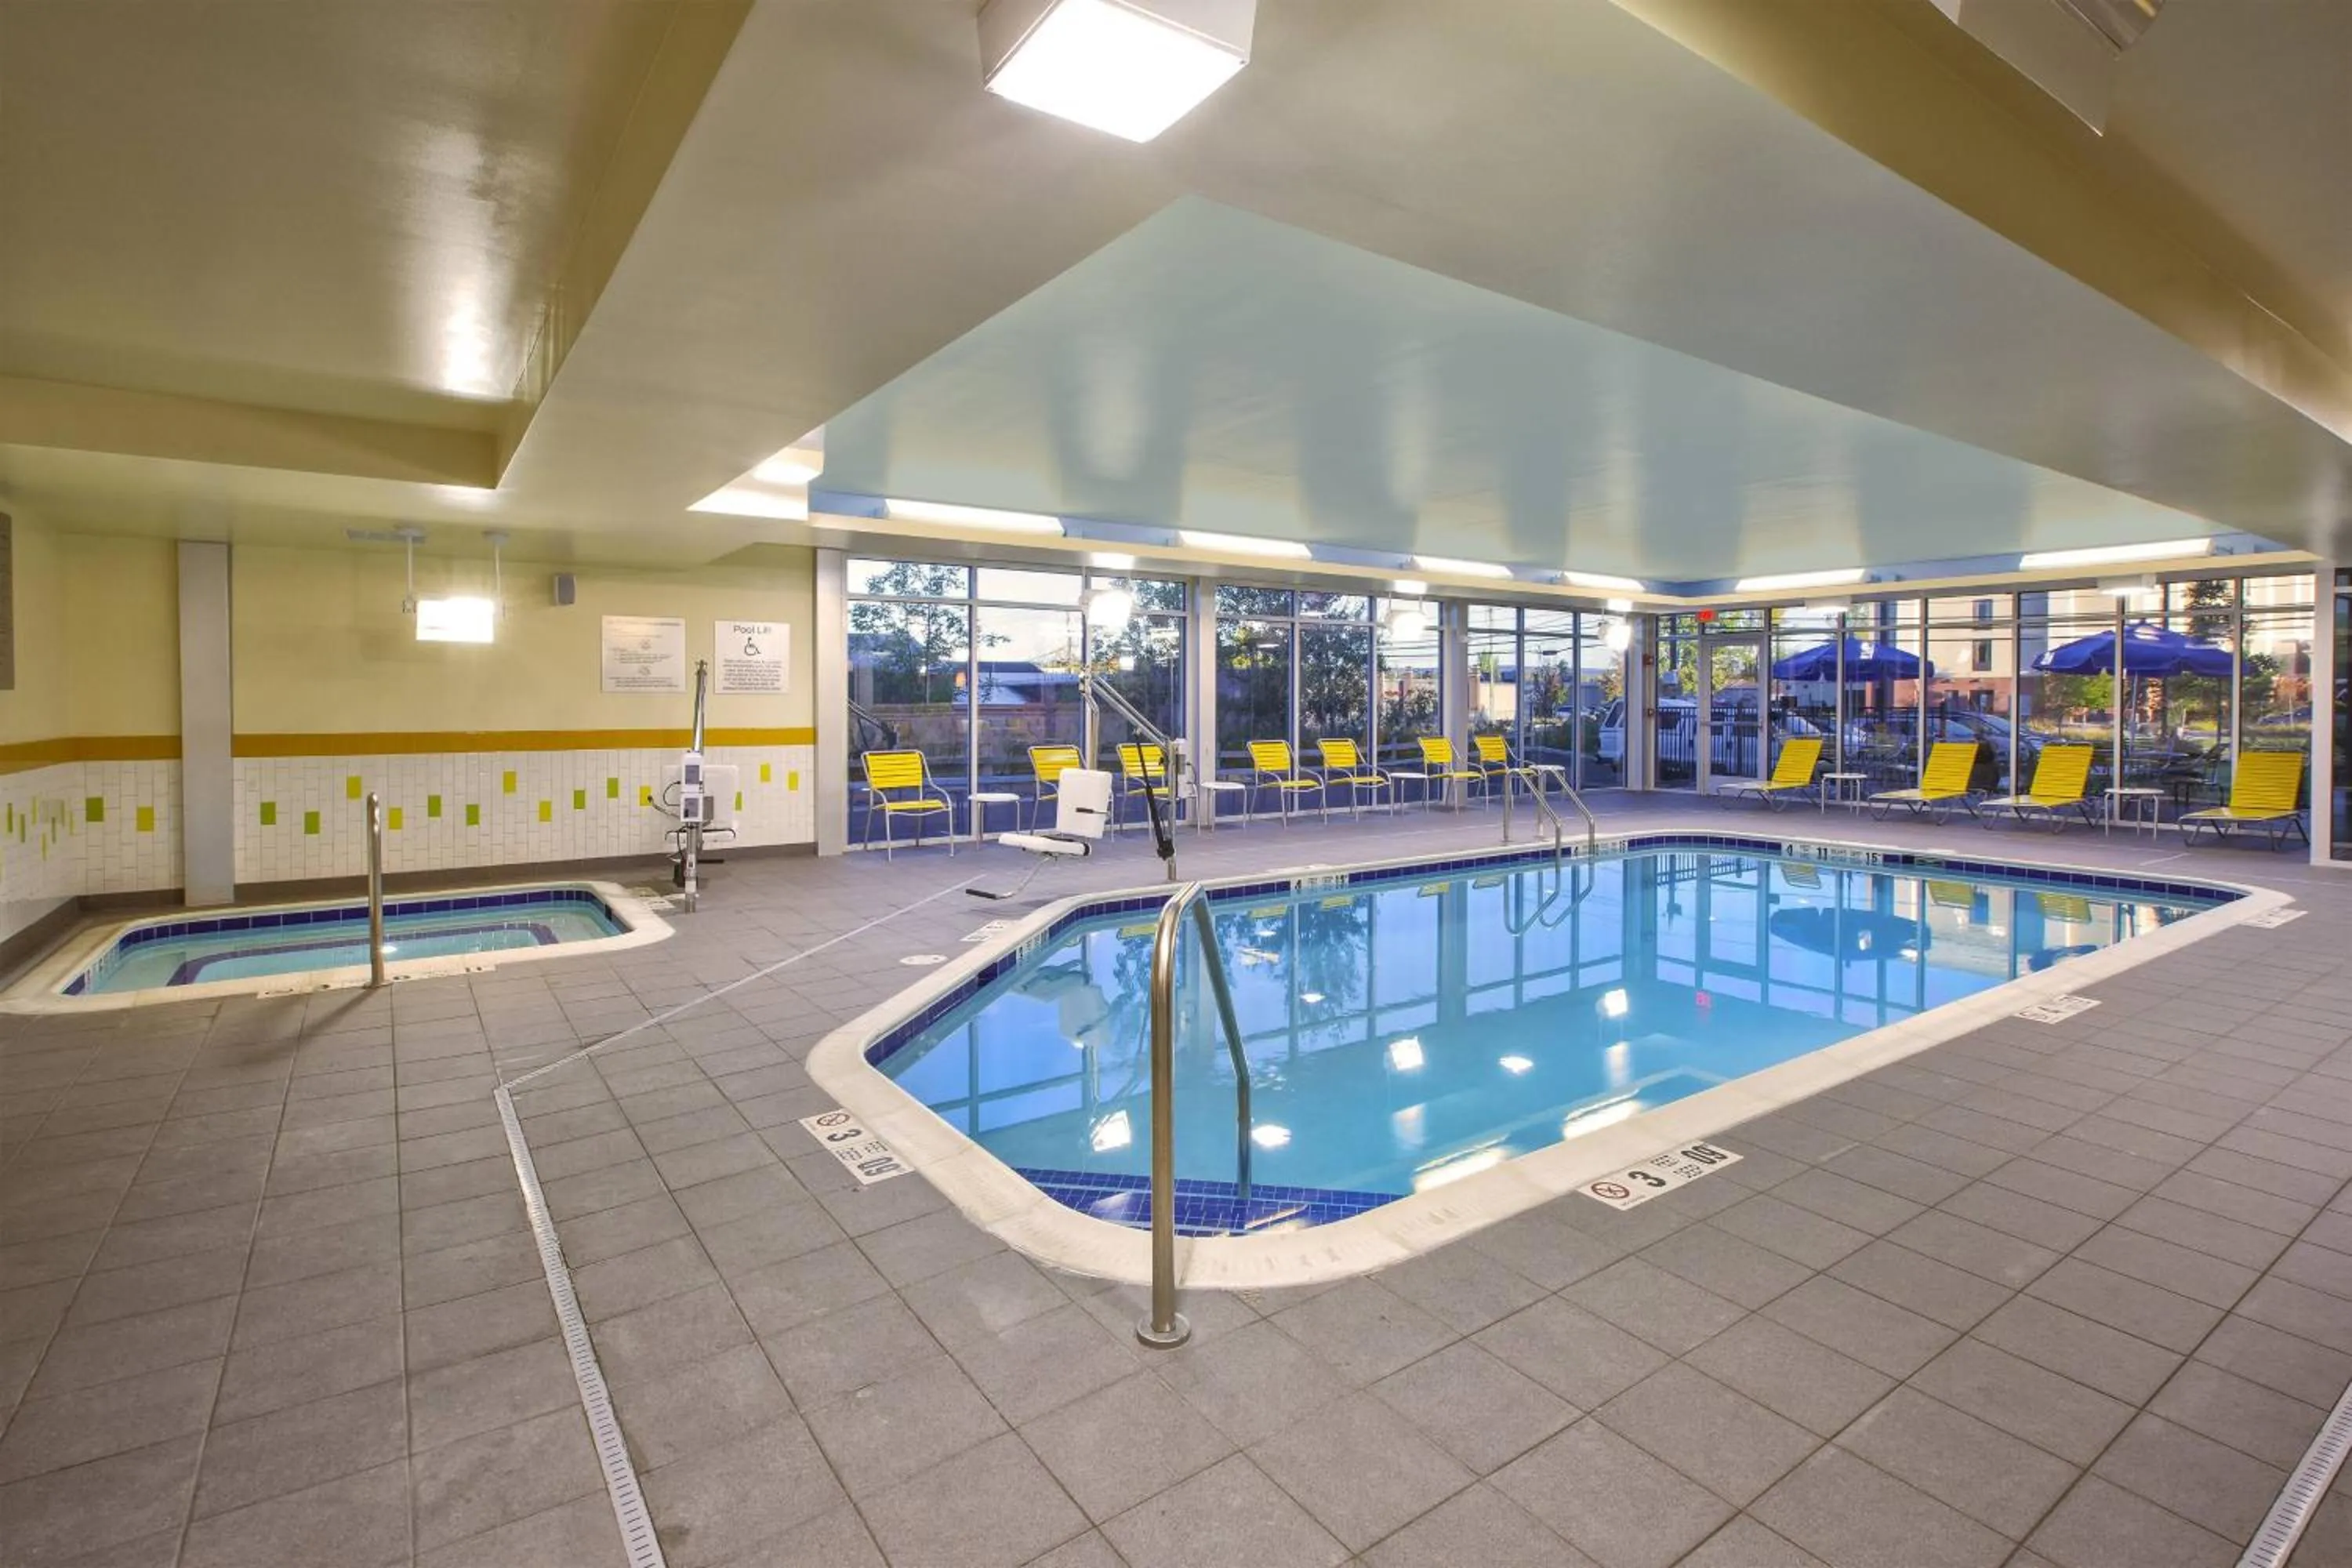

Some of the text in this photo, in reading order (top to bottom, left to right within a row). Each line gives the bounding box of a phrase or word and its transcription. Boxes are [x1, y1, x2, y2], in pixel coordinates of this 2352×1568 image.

[733, 625, 755, 634] Pool
[827, 1128, 862, 1142] 3
[1628, 1171, 1666, 1188] 3
